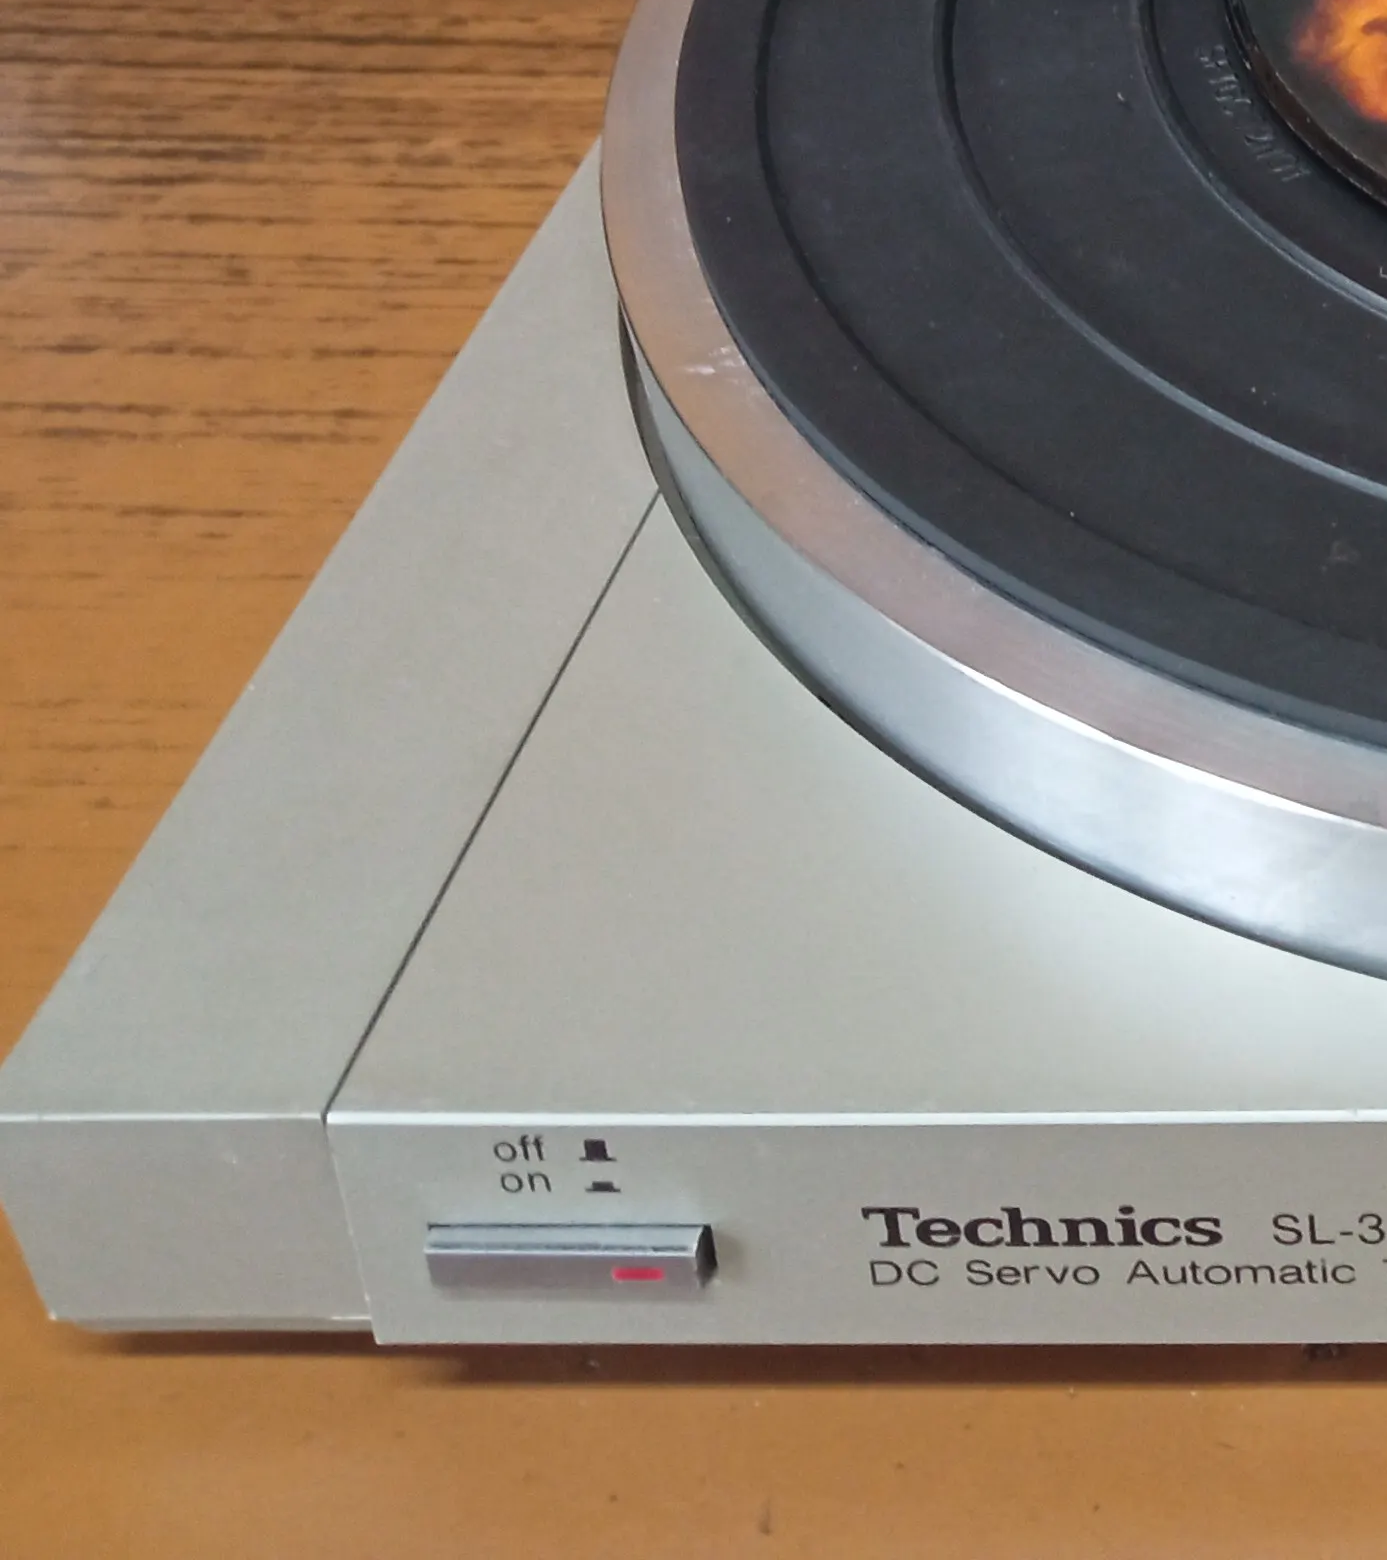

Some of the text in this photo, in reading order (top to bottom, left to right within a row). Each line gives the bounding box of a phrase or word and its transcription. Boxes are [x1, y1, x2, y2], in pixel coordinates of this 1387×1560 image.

[493, 1134, 545, 1162] off
[500, 1169, 552, 1194] on
[861, 1205, 1386, 1248] Technics SL-3
[869, 1258, 940, 1287] DC
[965, 1258, 1100, 1287] Servo
[1126, 1257, 1357, 1286] Automatic
